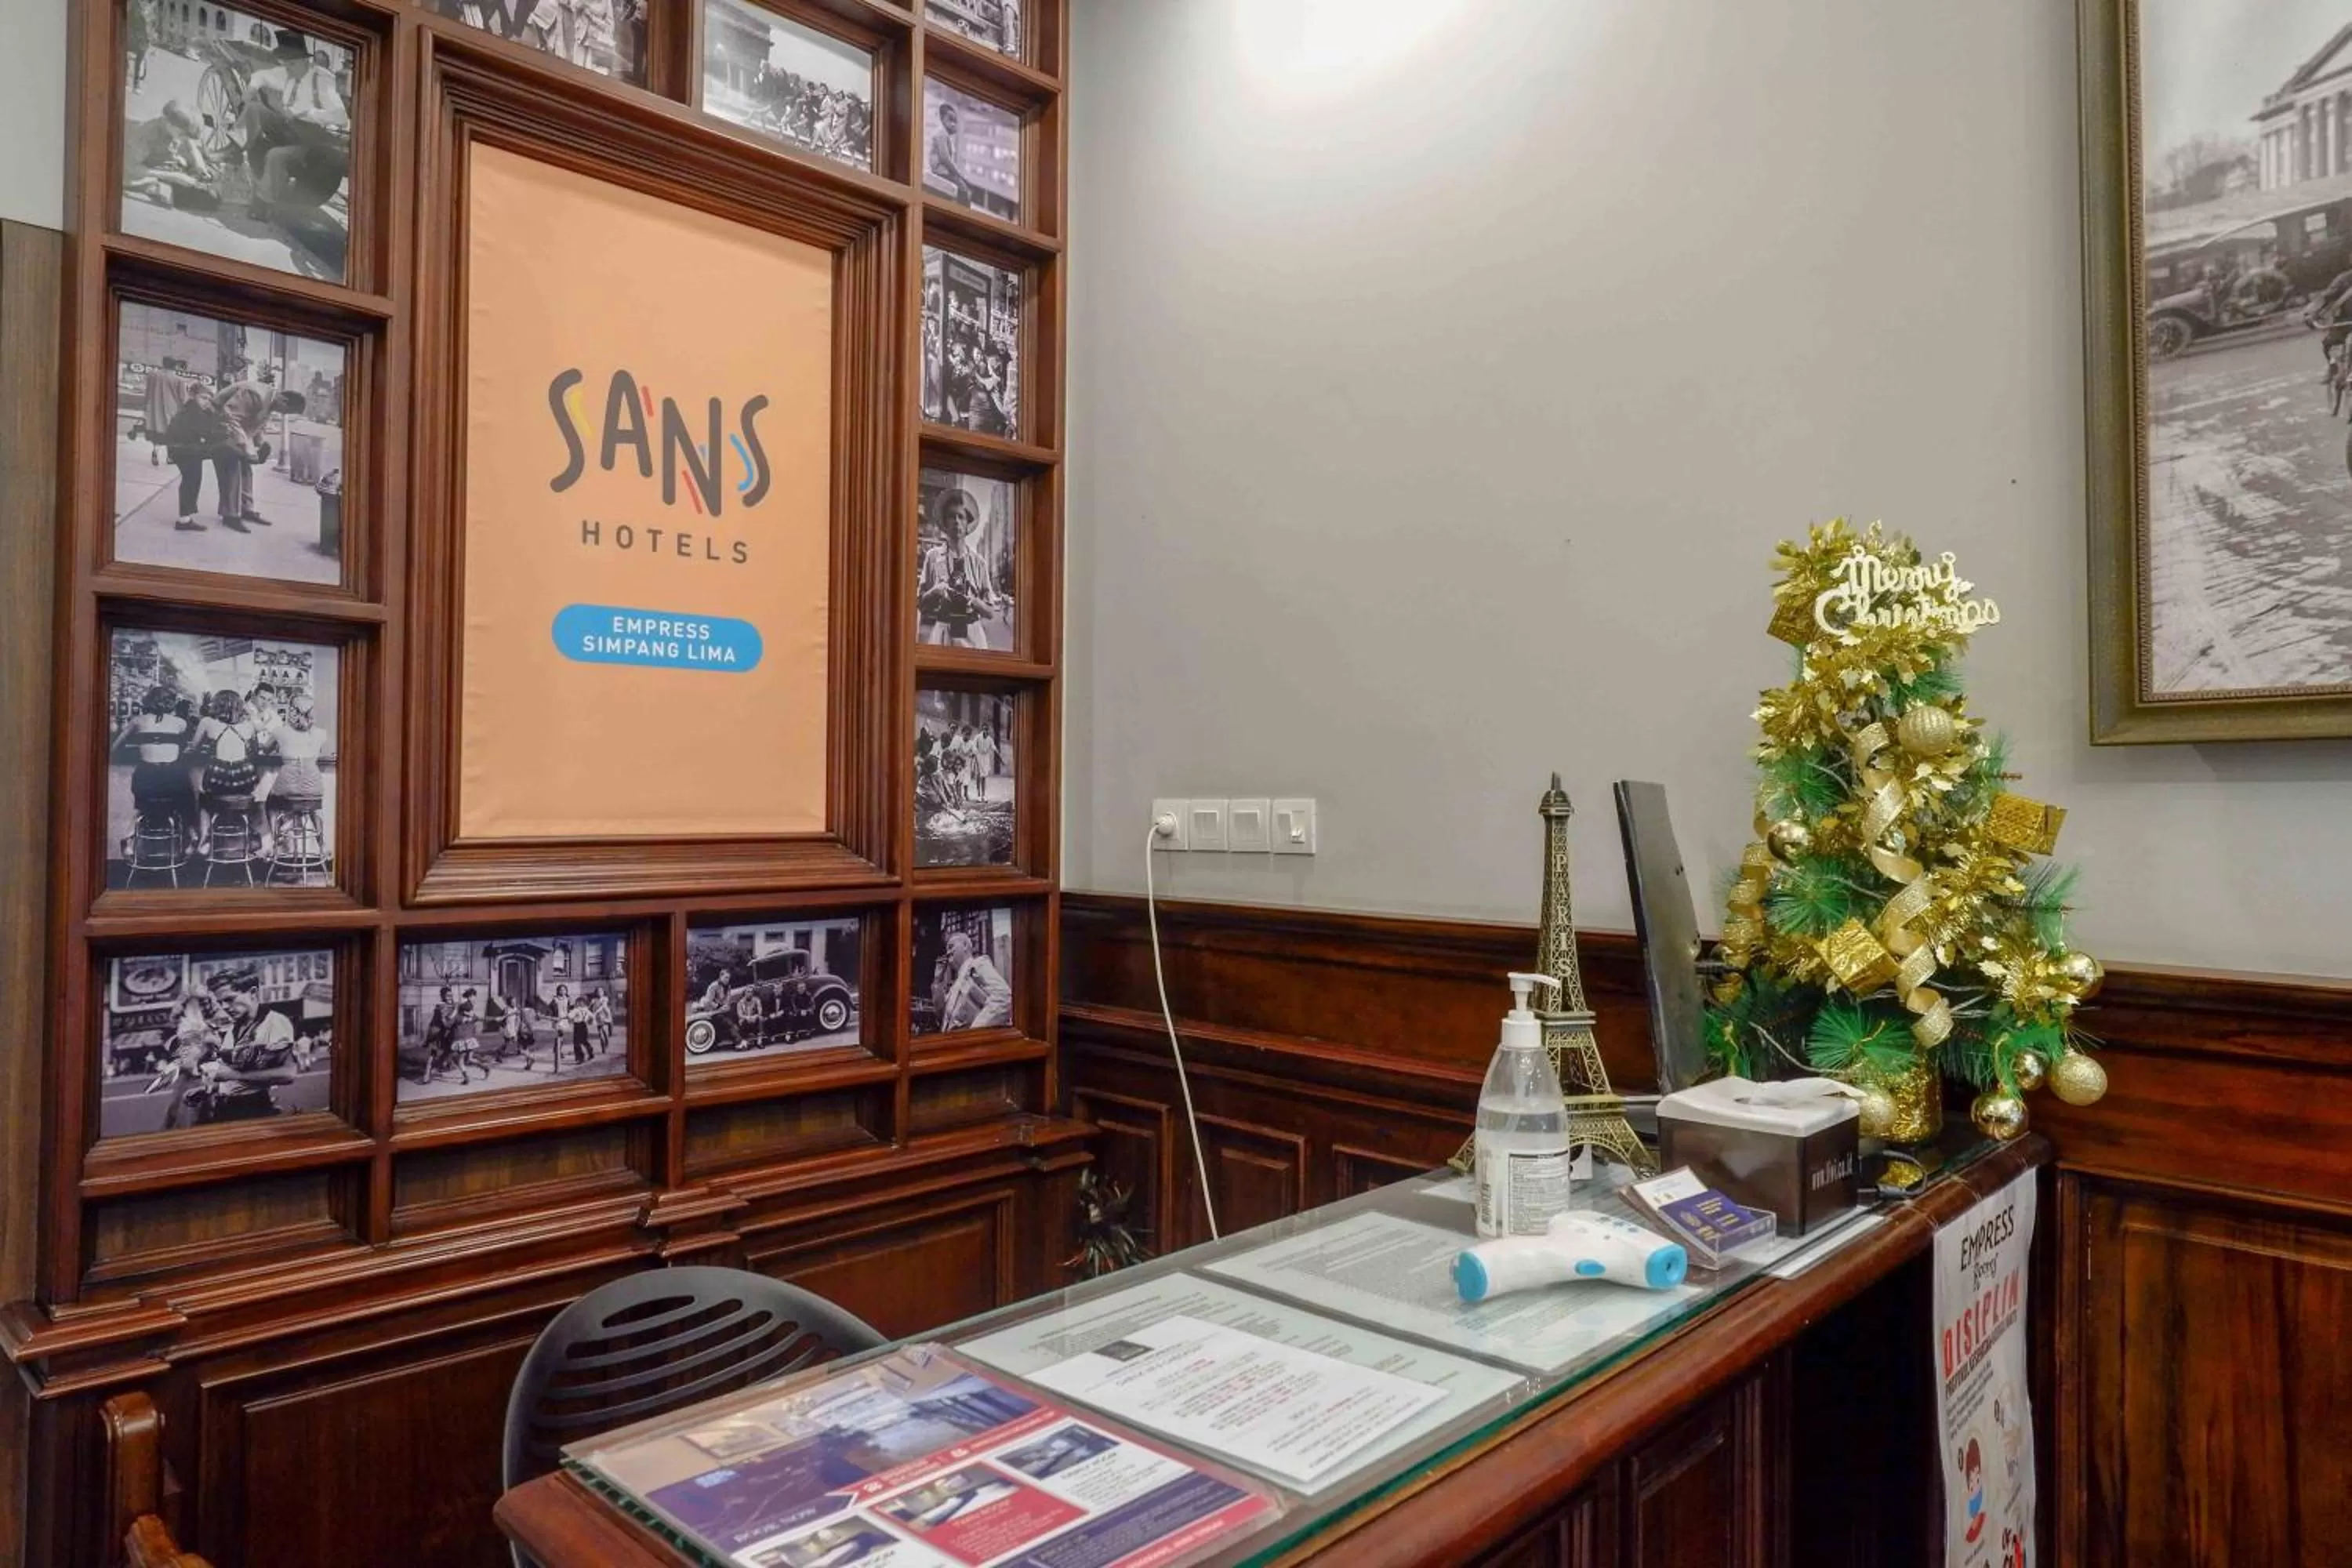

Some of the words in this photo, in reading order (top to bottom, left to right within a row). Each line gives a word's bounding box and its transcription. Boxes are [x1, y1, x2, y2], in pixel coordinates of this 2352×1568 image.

[549, 368, 771, 517] SANS
[582, 520, 749, 564] HOTELS
[583, 636, 680, 659] SIMPANG
[688, 644, 735, 663] LIMA
[613, 615, 710, 641] EMPRESS
[1961, 1204, 2013, 1272] EMPRESS
[1943, 1267, 2020, 1380] DISIPLIN
